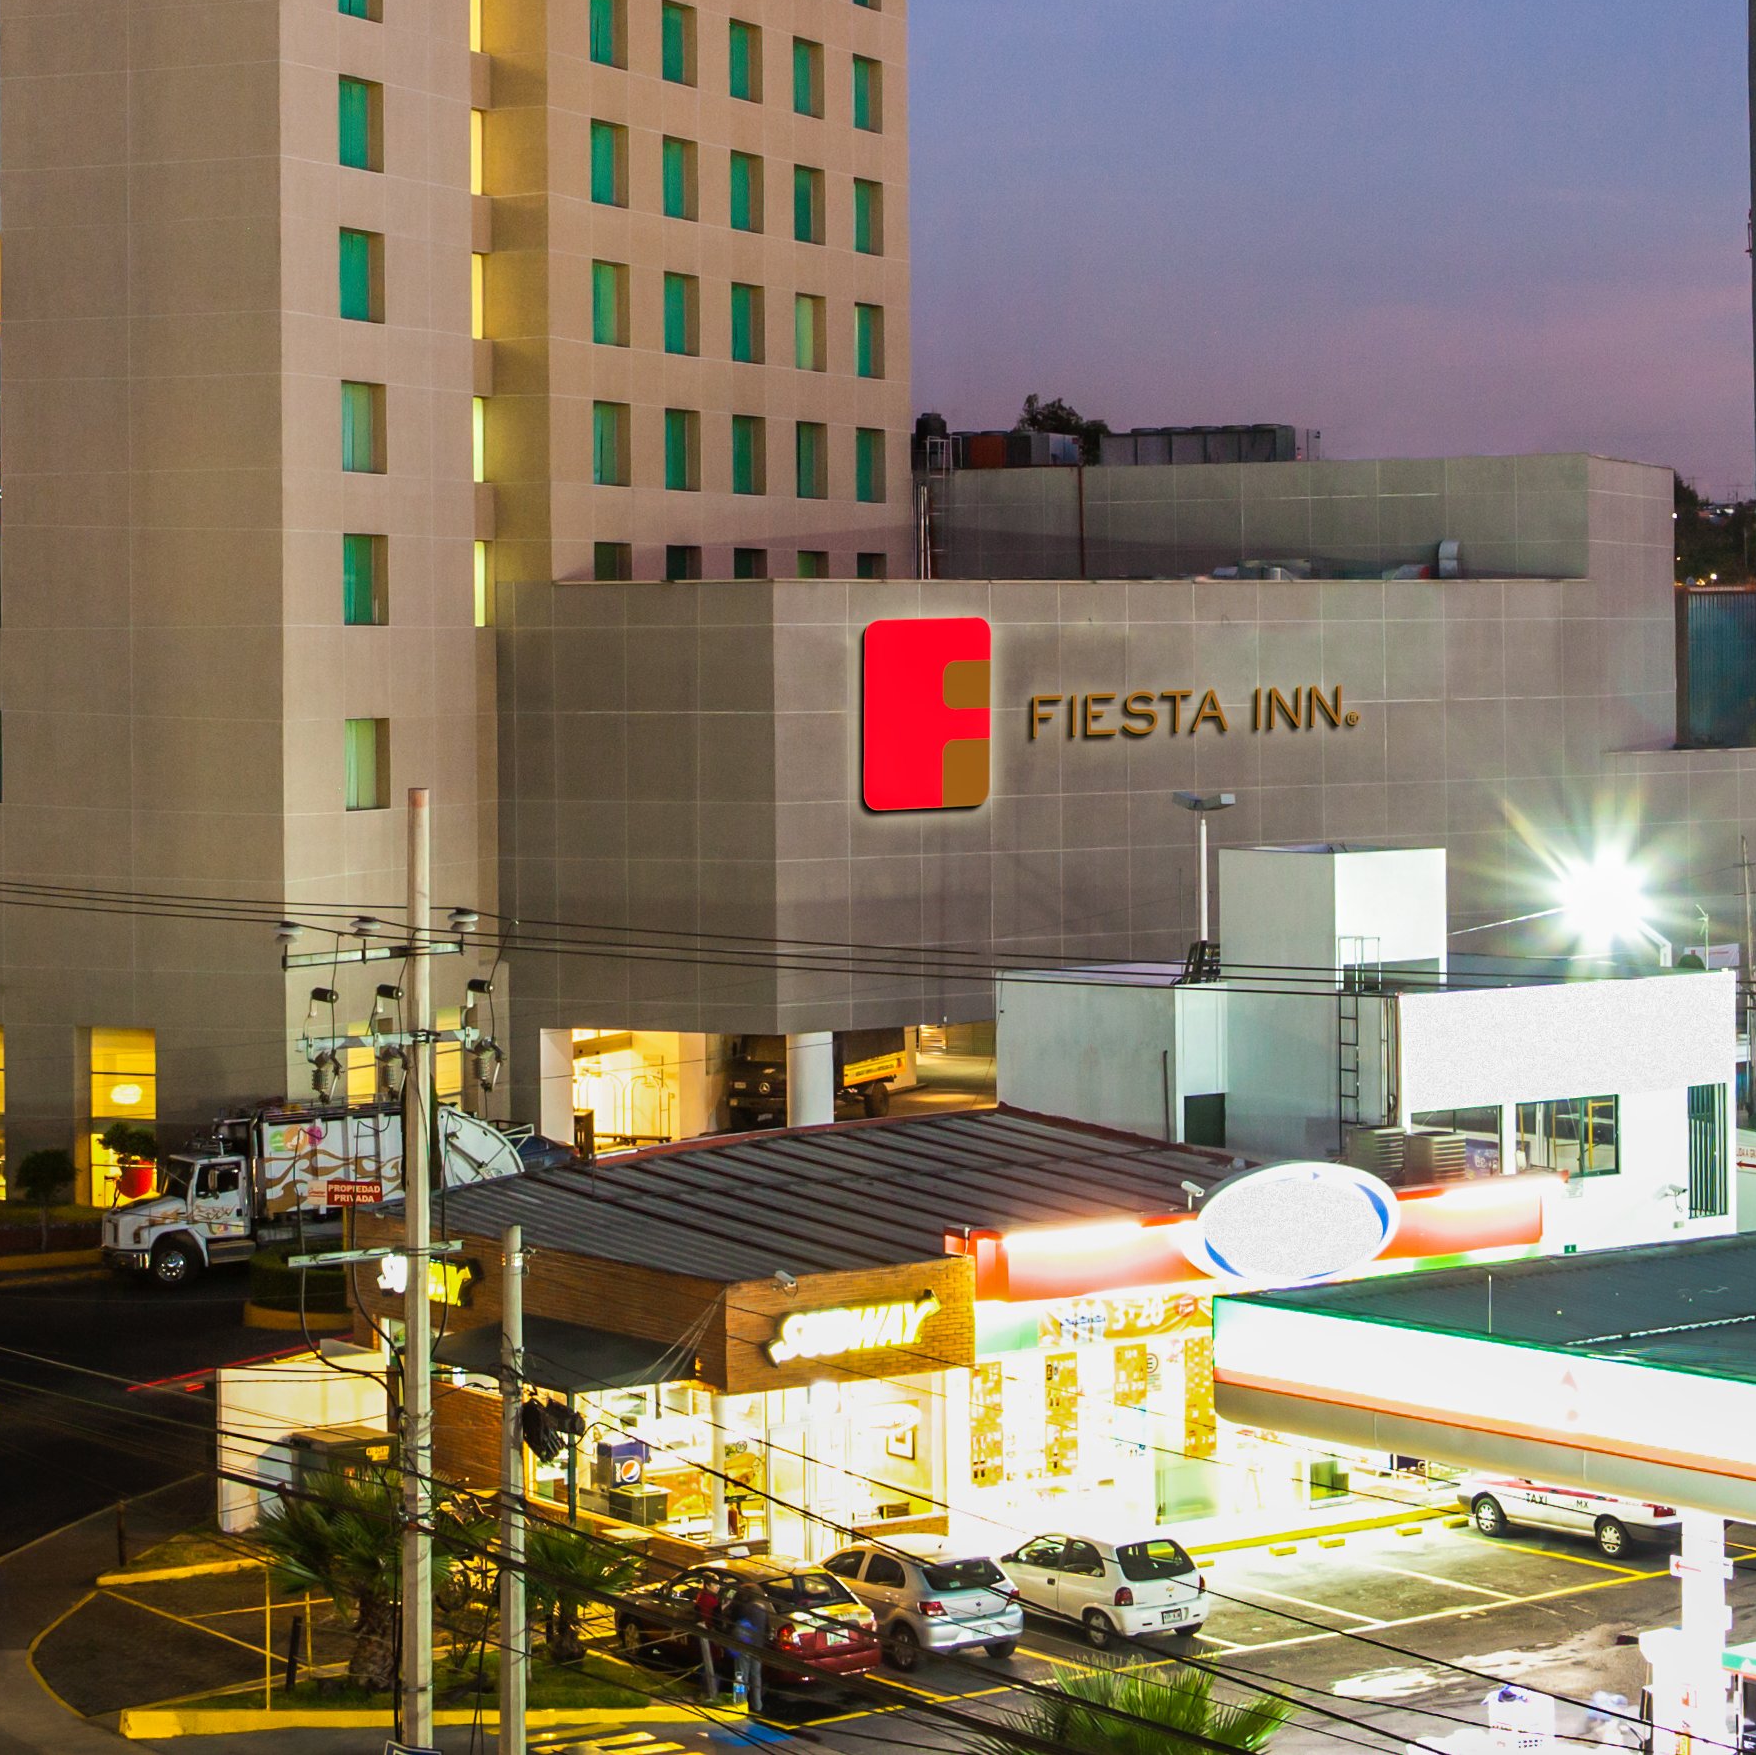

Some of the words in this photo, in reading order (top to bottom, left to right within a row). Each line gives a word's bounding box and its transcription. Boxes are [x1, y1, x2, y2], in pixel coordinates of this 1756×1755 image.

[1031, 689, 1229, 741] FIESTA
[328, 1184, 381, 1193] PROPIEDAD
[334, 1194, 375, 1203] PRIVADA
[769, 1290, 942, 1364] SUBWAY
[1526, 1493, 1548, 1505] TAXI
